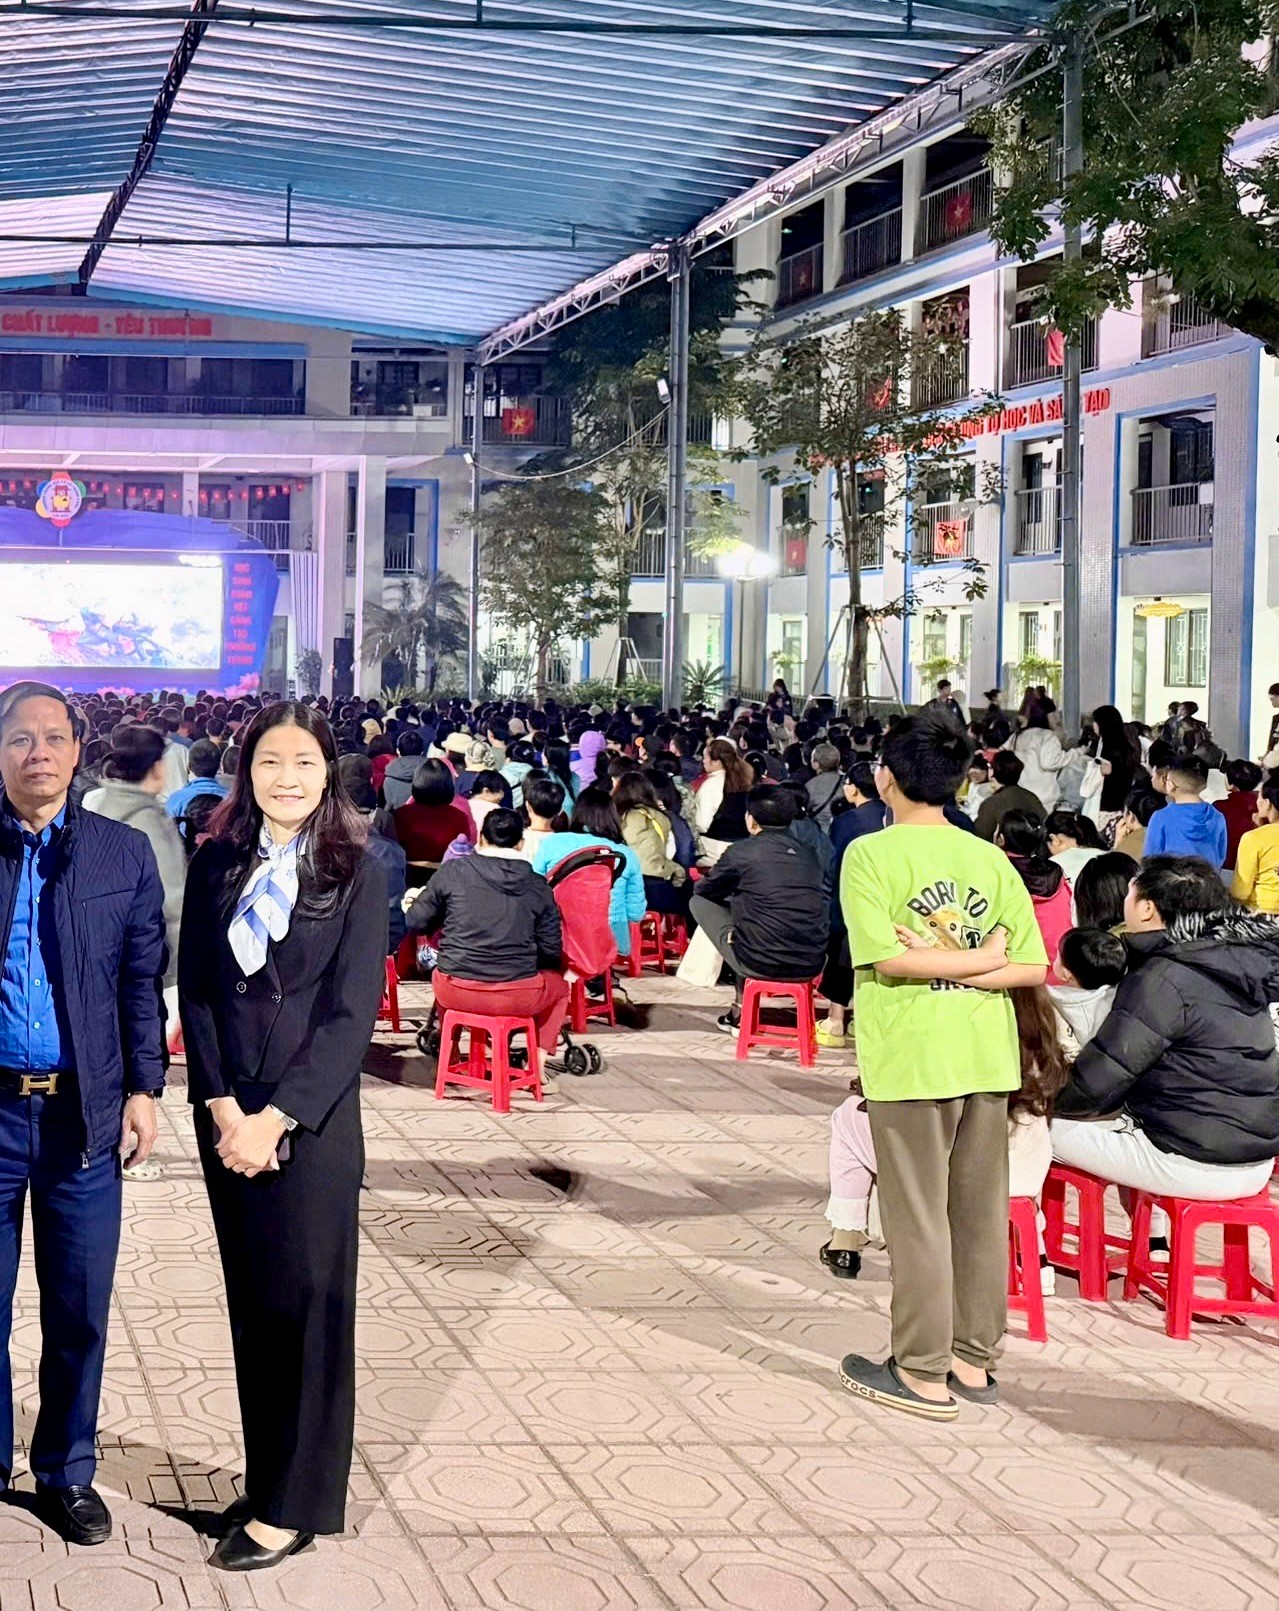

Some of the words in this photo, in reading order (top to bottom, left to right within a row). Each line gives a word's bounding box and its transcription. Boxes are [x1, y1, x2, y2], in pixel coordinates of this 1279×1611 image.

[1001, 405, 1027, 432] HỌC
[1029, 397, 1045, 424] VÀ
[1083, 388, 1111, 417] TẠO
[964, 887, 988, 918] TO
[840, 1374, 876, 1398] crocs
